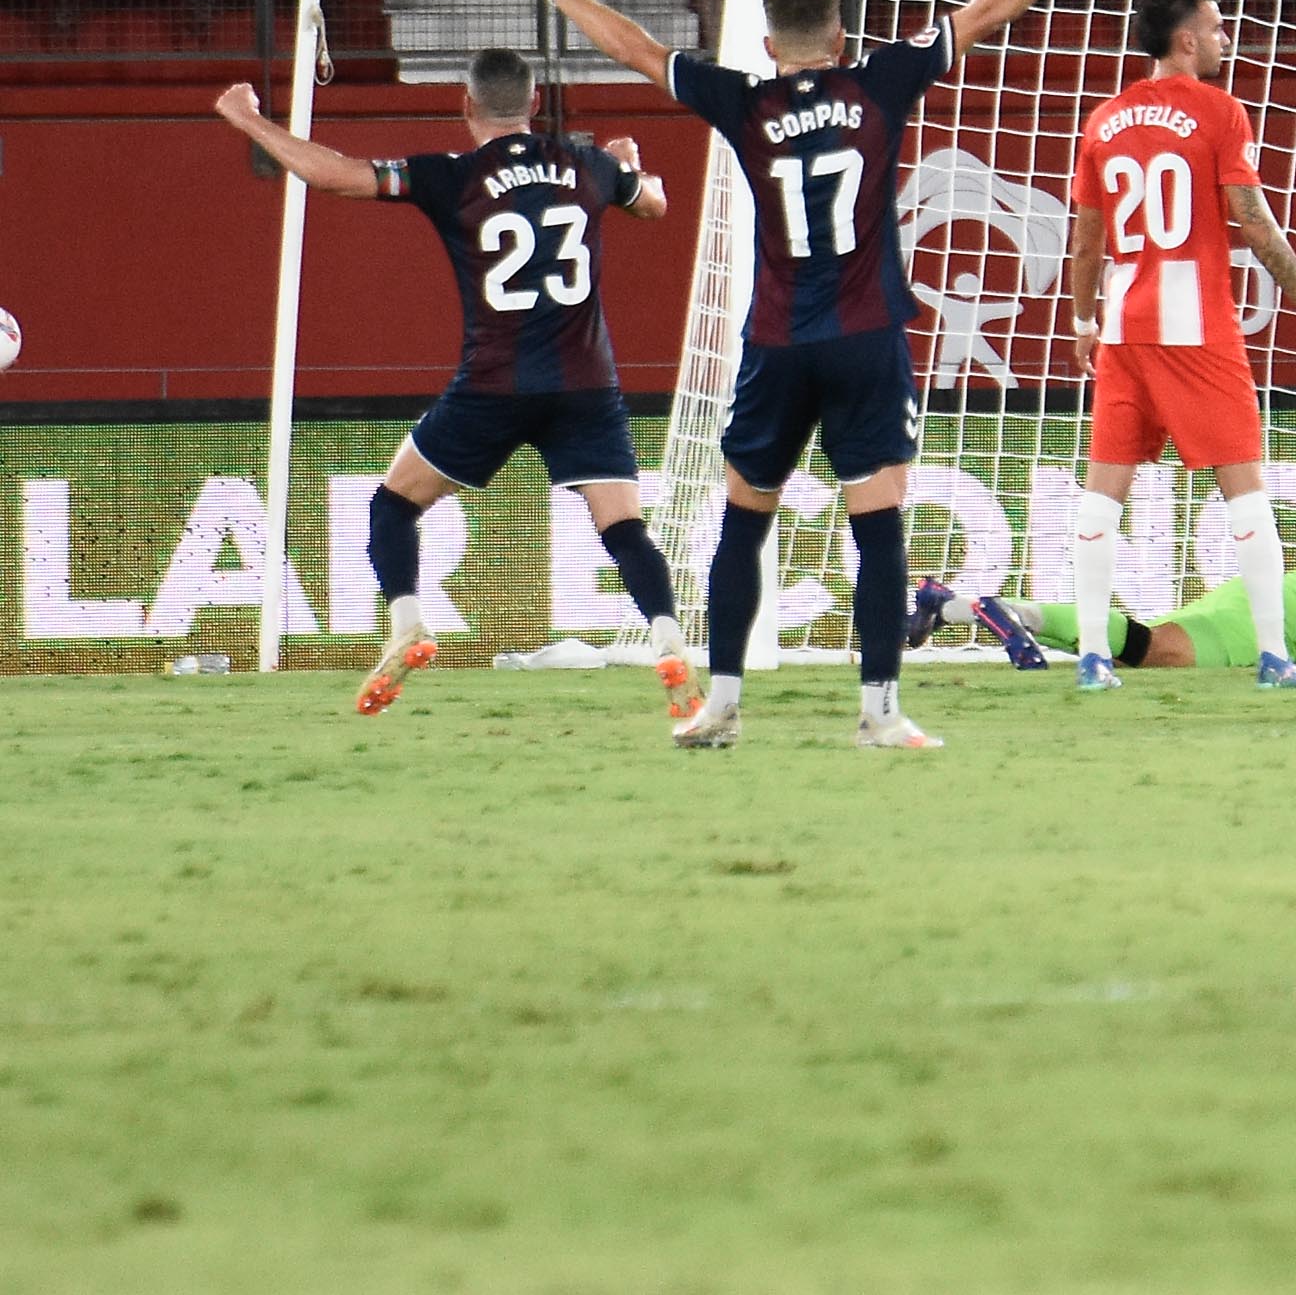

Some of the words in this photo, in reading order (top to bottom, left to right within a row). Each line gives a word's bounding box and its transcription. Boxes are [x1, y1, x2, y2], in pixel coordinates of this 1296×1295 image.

[763, 102, 864, 145] CORPAS
[1099, 105, 1198, 142] GENTELLES
[484, 162, 577, 199] ARBILLA
[769, 148, 865, 259] 17
[1104, 152, 1193, 254] 20
[480, 204, 592, 313] 23
